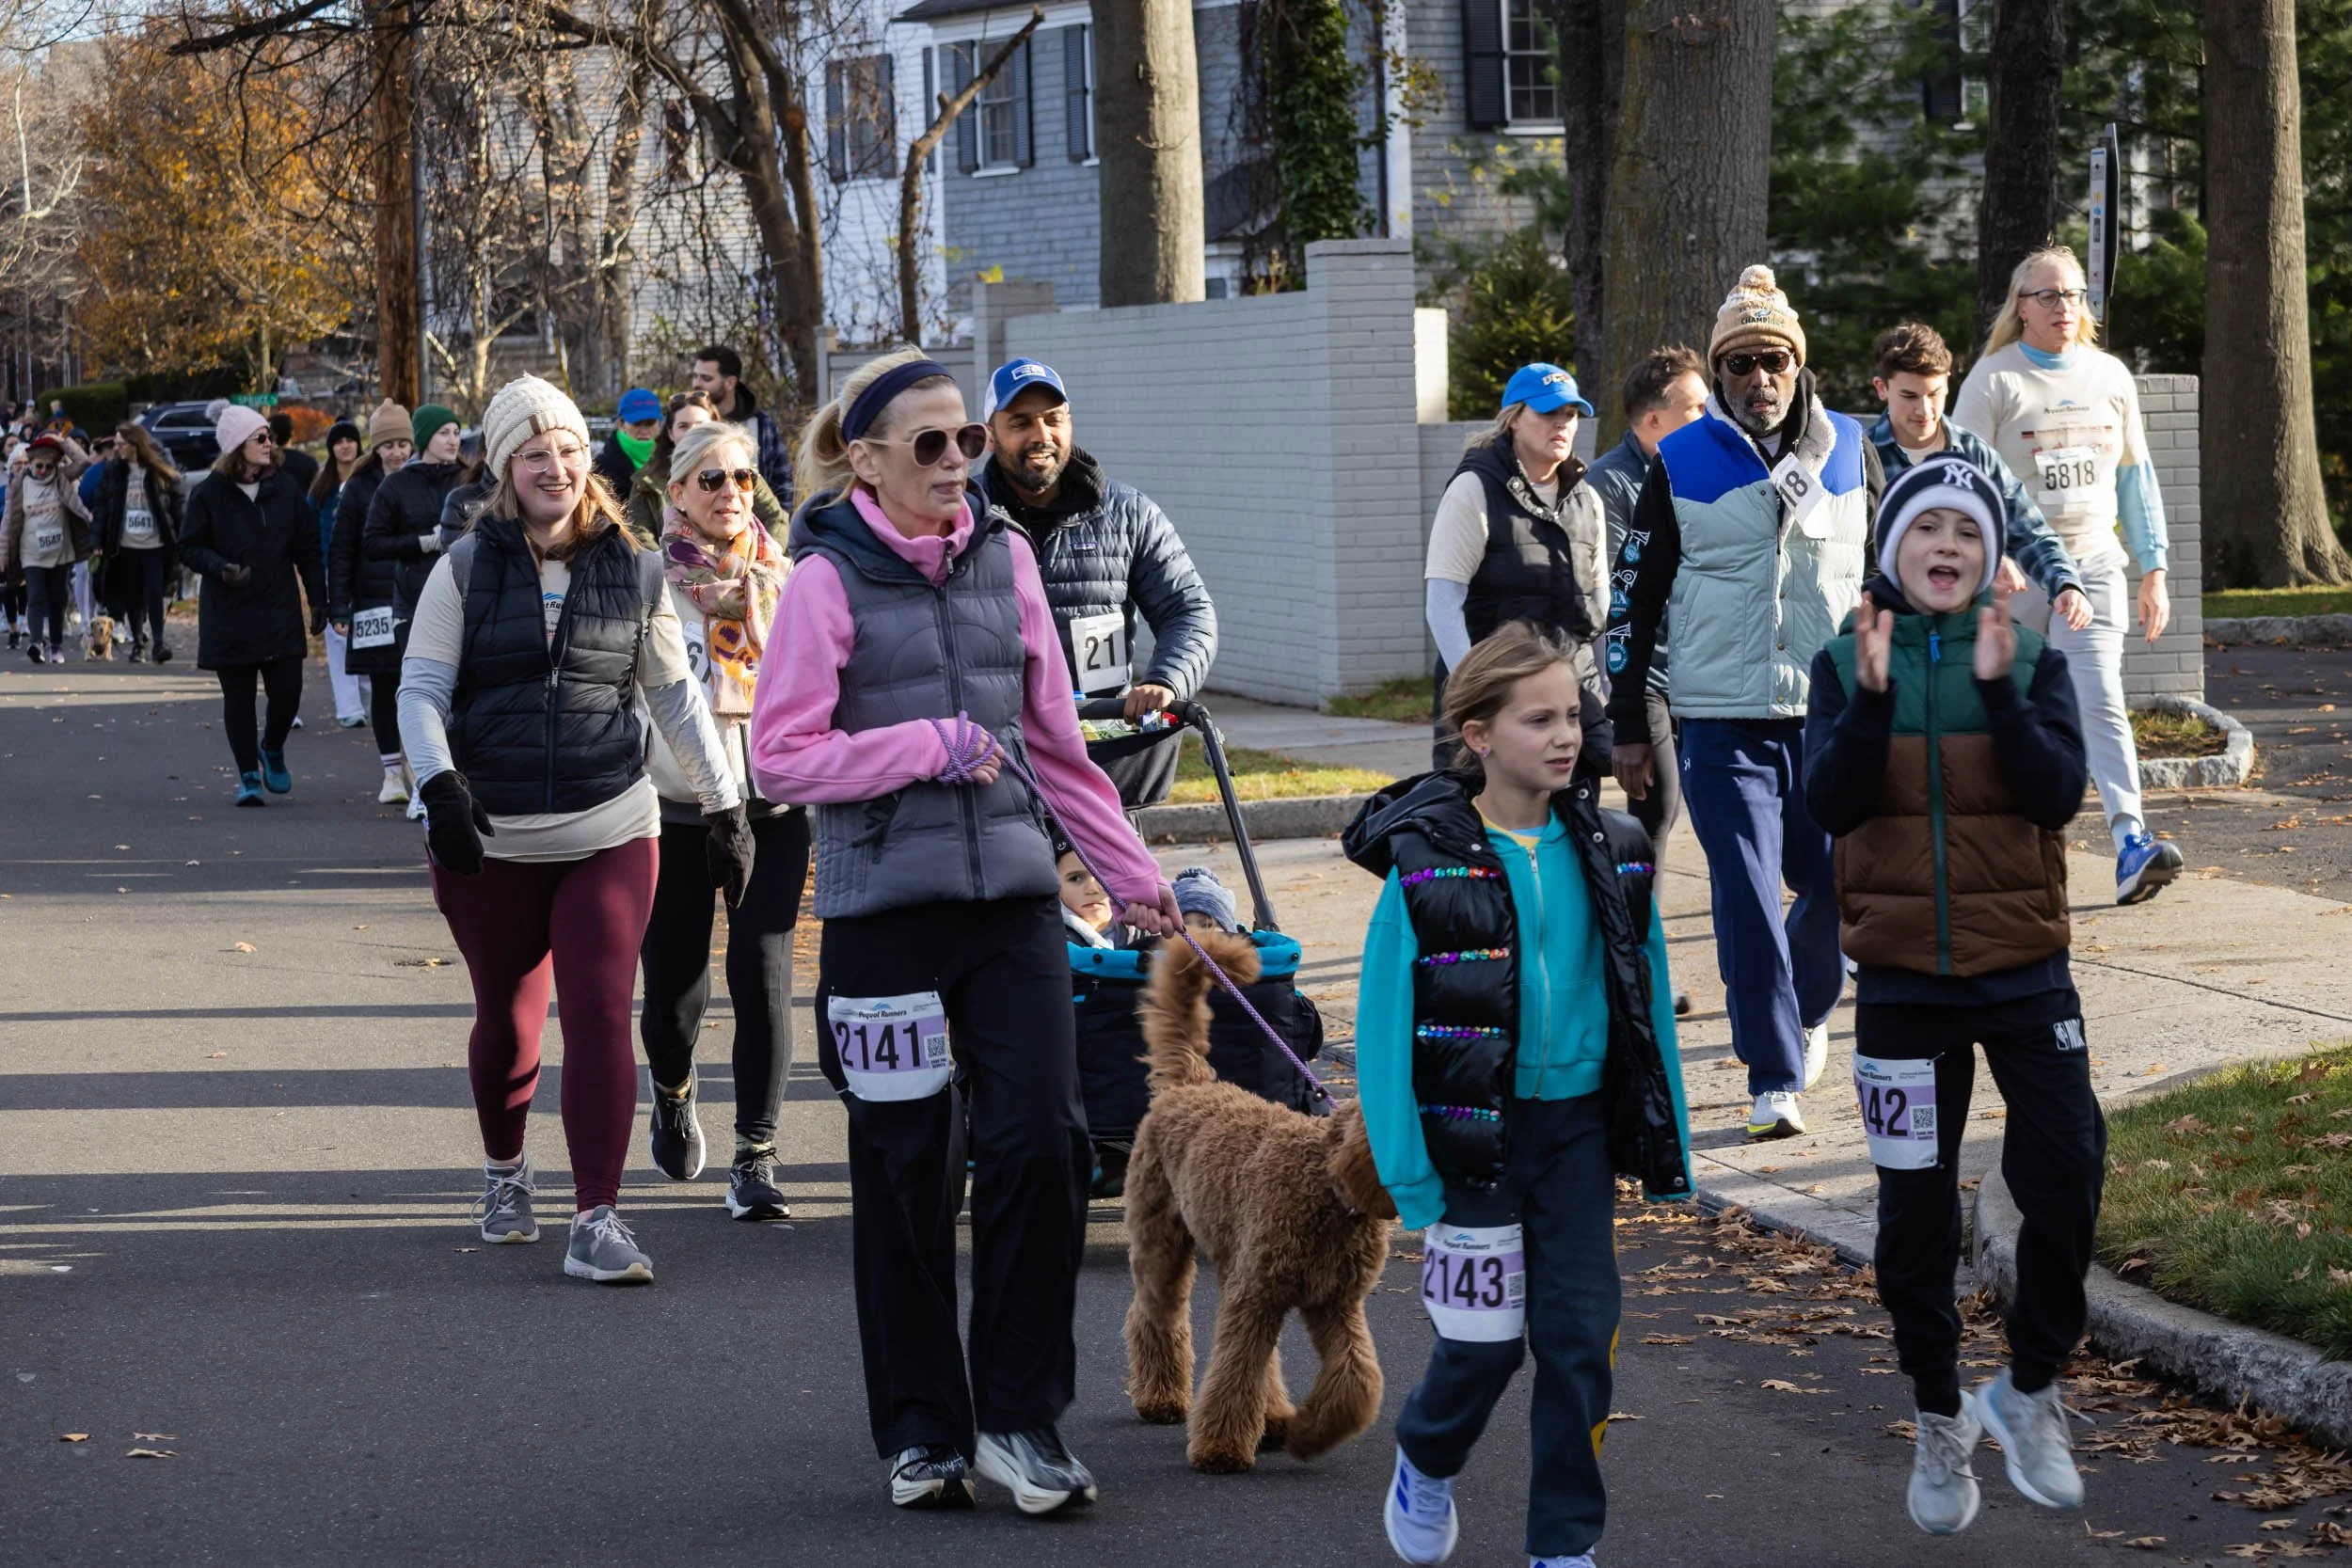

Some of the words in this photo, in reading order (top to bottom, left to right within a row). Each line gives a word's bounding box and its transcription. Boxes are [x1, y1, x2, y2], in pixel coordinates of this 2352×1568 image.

[2044, 459, 2095, 491] 5818
[356, 616, 389, 639] 5235
[1085, 632, 1116, 671] 21
[835, 1021, 921, 1070] 2141
[1423, 1247, 1504, 1308] 2143
